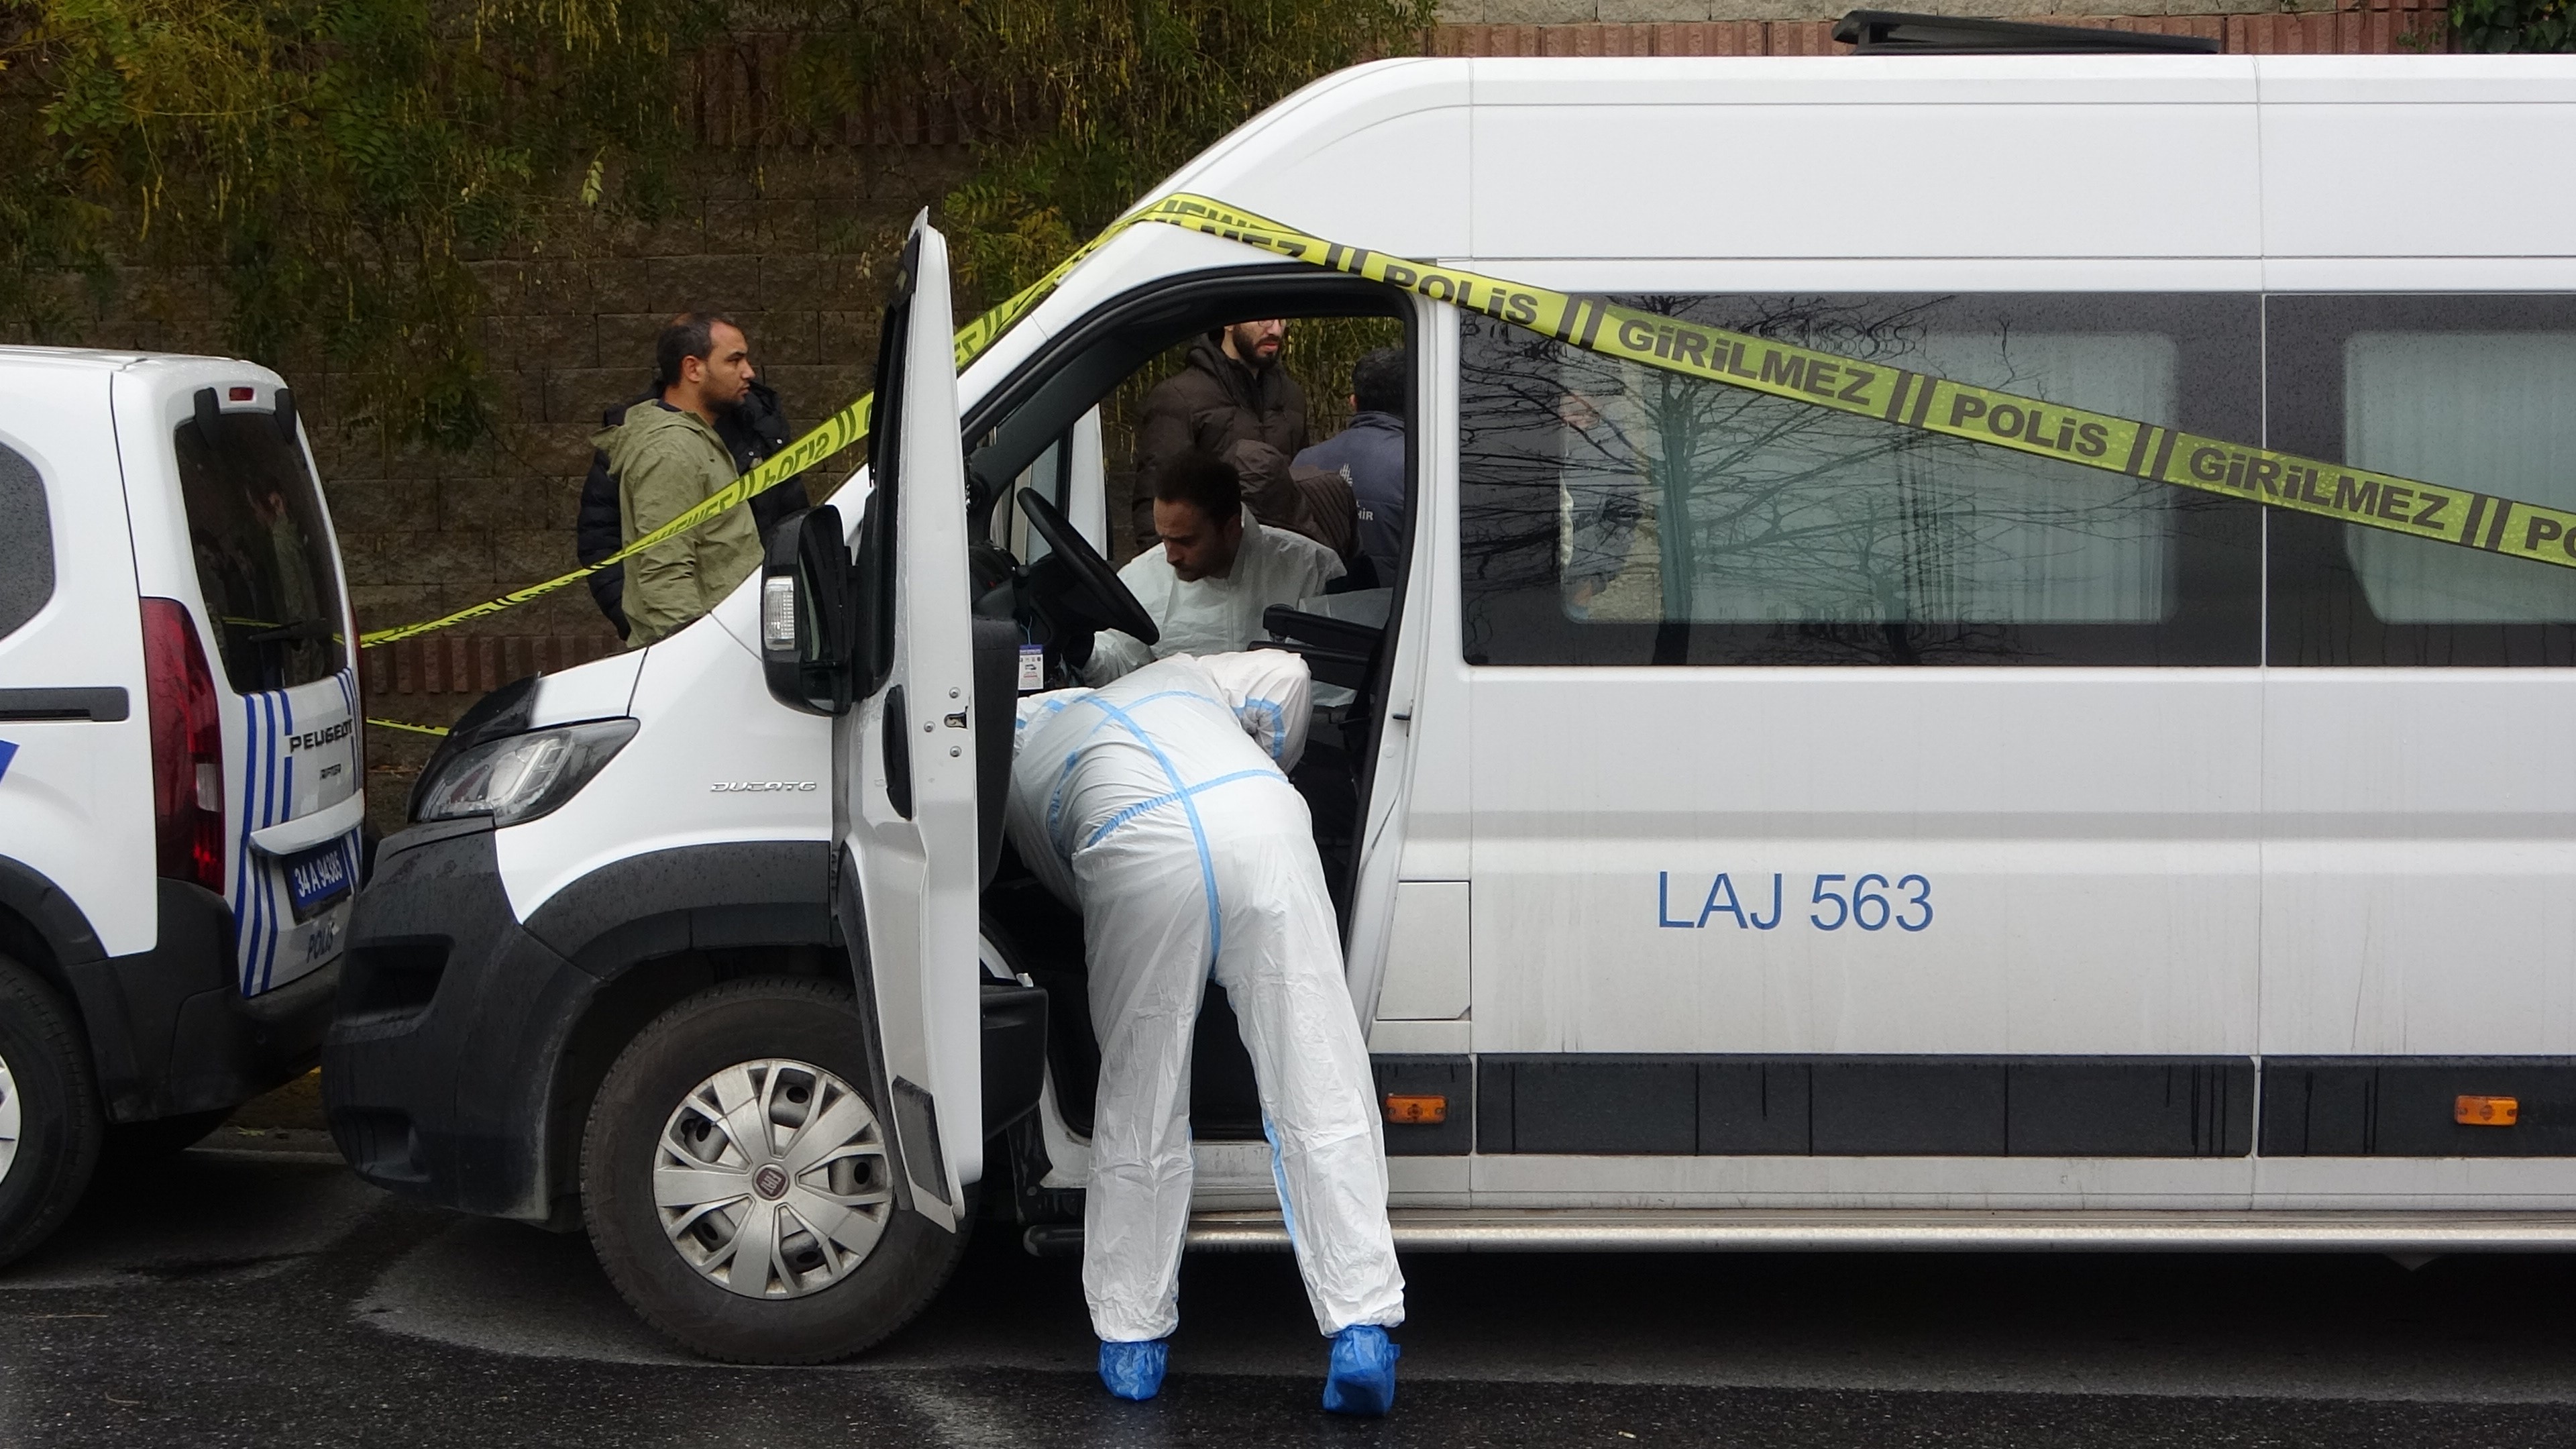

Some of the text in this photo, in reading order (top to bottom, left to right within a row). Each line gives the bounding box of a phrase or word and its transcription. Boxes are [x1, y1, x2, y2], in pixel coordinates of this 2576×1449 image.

[290, 718, 353, 753] PEUGEOT
[710, 781, 816, 792] DUCATO
[294, 865, 312, 898] 34
[309, 861, 321, 892] A
[1660, 871, 1933, 932] LAJ 563
